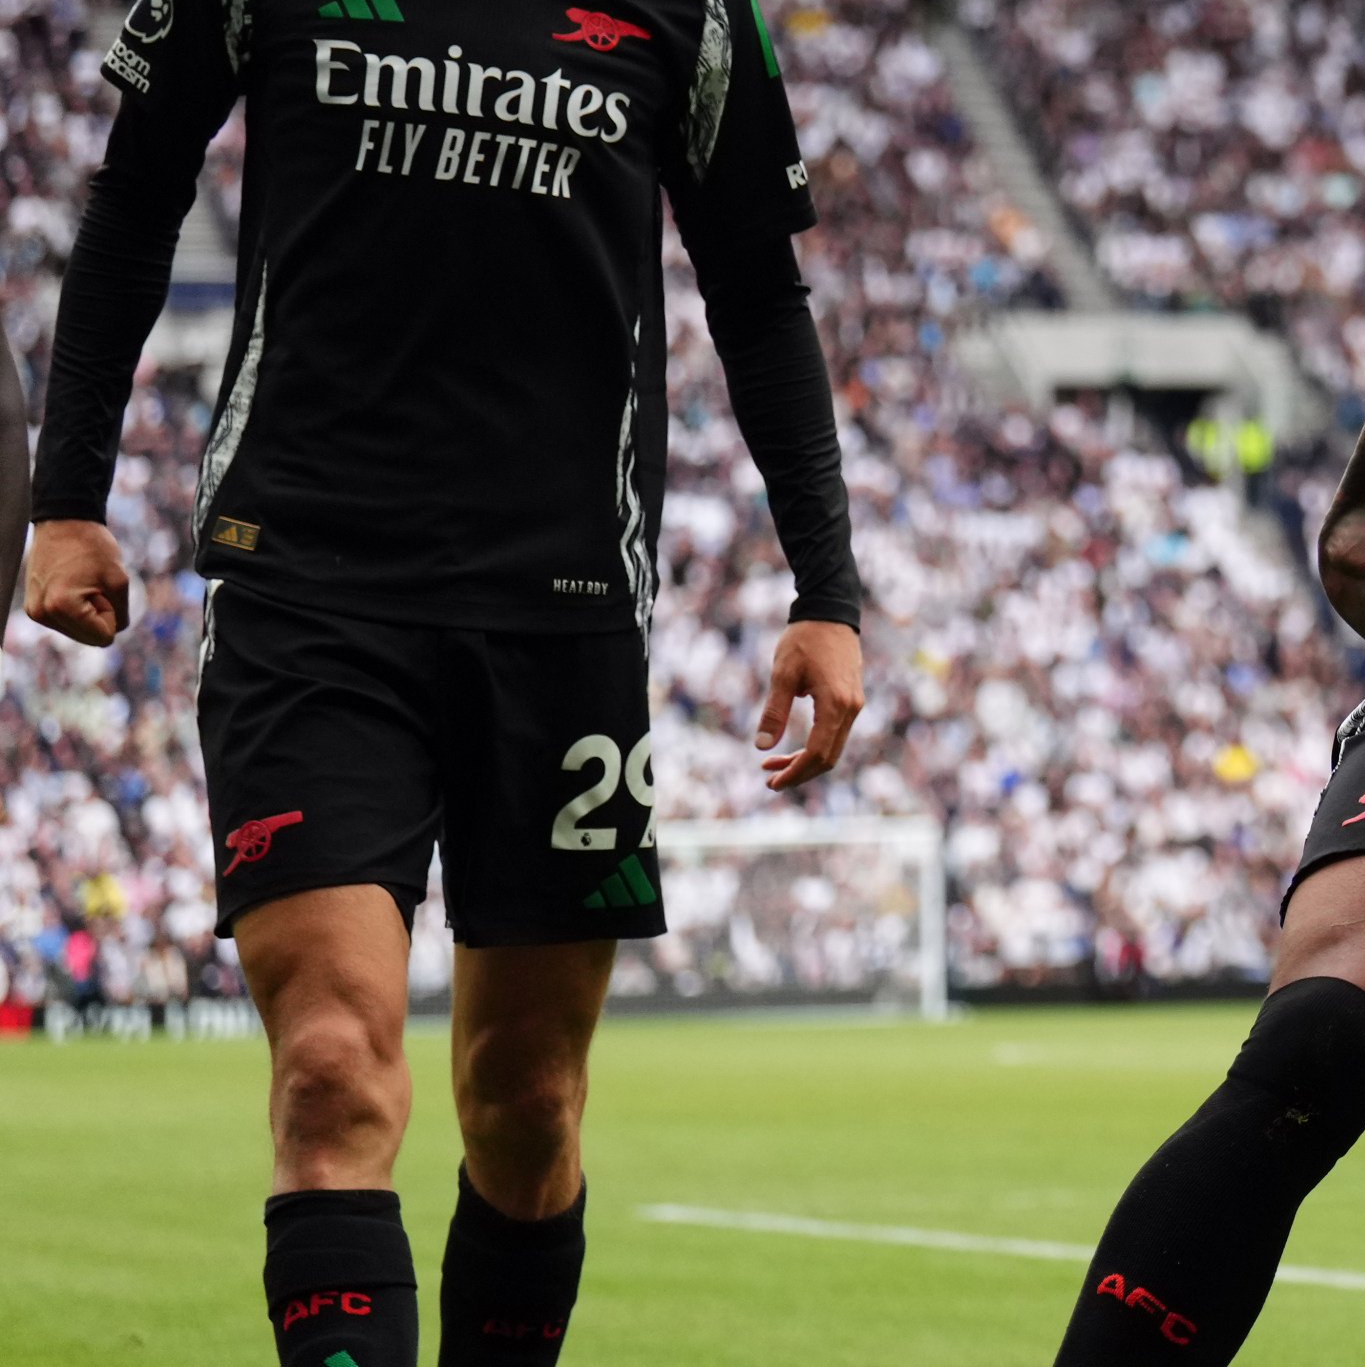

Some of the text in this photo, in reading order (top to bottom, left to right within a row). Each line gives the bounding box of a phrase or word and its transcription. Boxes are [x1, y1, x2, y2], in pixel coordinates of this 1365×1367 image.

[312, 38, 631, 144] Emirates
[355, 119, 581, 199] FLY BETTER
[551, 733, 656, 851] 29
[283, 1289, 371, 1331] AFC
[1096, 1272, 1198, 1347] AFC
